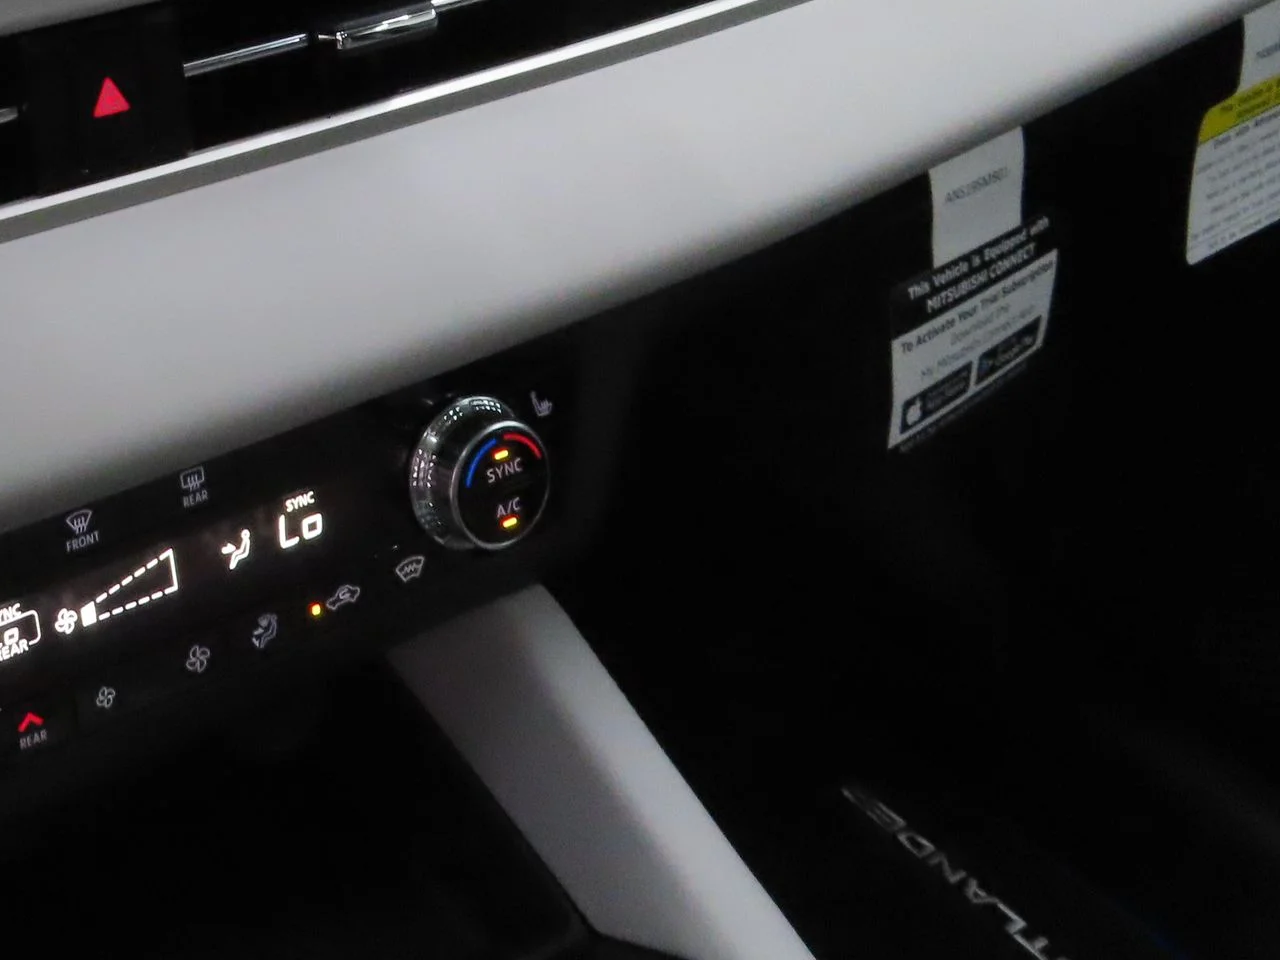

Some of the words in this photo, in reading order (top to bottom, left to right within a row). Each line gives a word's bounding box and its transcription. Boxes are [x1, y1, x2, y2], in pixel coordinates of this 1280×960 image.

[487, 457, 523, 484] SYNC
[182, 490, 209, 508] REAR
[285, 491, 315, 513] SYNC
[496, 496, 521, 518] A/C
[66, 530, 100, 553] FRONT
[277, 512, 322, 550] Lo
[19, 729, 48, 751] REAR
